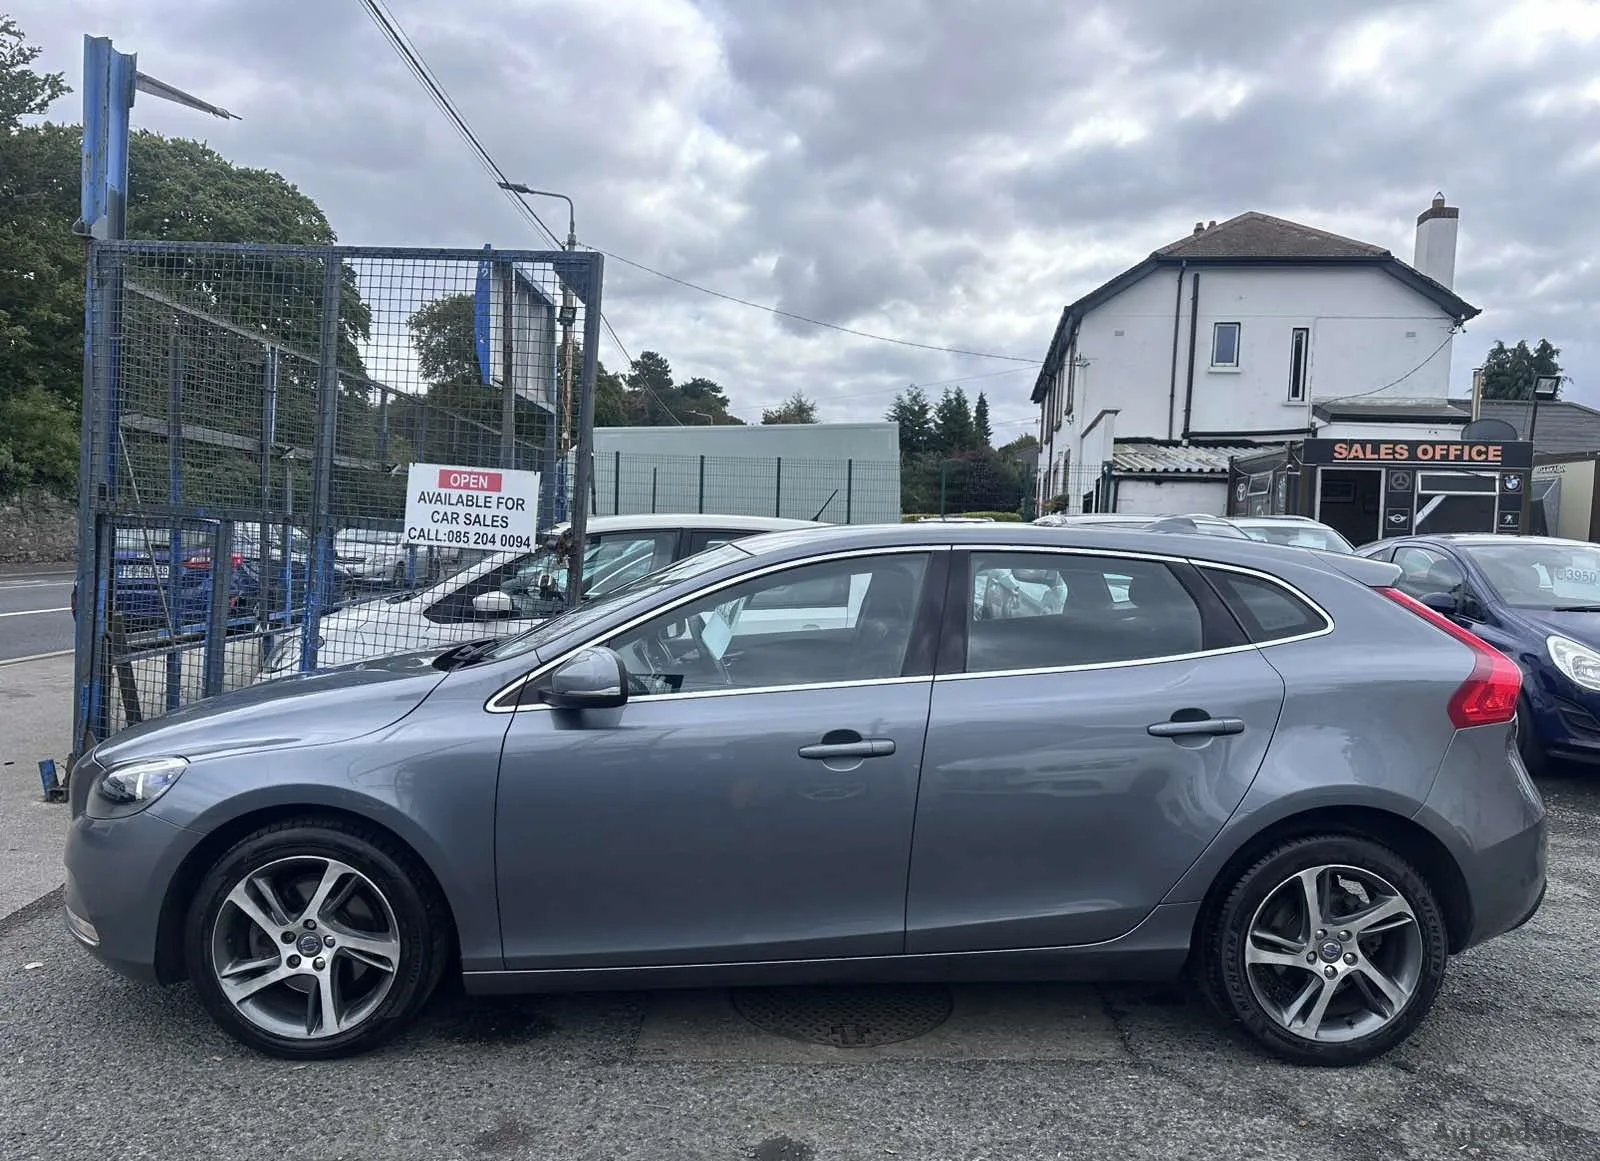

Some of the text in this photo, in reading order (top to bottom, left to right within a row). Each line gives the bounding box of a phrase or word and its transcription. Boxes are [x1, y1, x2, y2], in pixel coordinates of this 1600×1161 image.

[1333, 442, 1503, 462] SALES OFFICE
[449, 473, 488, 489] OPEN
[417, 490, 525, 511] AVAILABLE FOR
[431, 510, 509, 529] CAR SALES
[407, 526, 531, 549] CALL:085 204 0094
